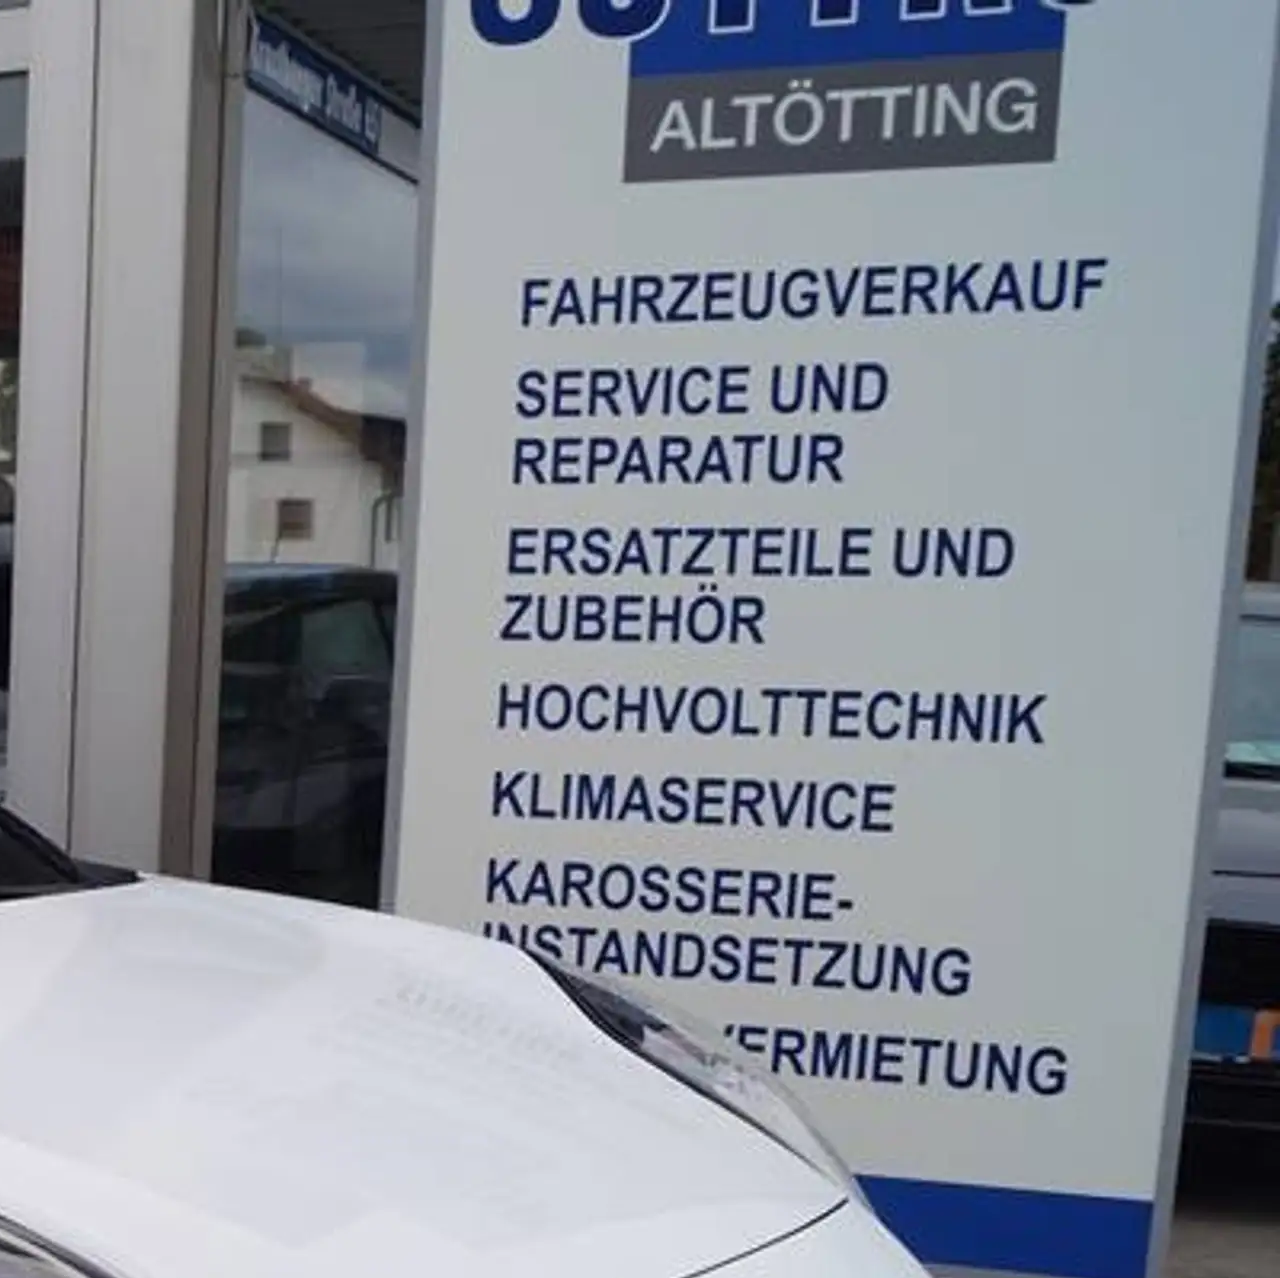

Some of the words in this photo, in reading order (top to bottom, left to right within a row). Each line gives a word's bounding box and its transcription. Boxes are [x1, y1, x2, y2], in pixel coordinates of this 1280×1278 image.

[650, 80, 1035, 151] ALTÖTTING
[522, 258, 1108, 327] FAHRZEUGVERKAUF
[516, 366, 750, 418] SERVICE
[771, 363, 888, 413] UND
[513, 434, 843, 484] REPARATUR
[508, 528, 872, 576] ERSATZTEILE
[894, 528, 1014, 577] UND
[500, 584, 764, 644] ZUBEHÖR
[498, 684, 1046, 743] HOCHVOLTTECHNIK
[493, 772, 895, 832] KLIMASERVICE
[487, 858, 853, 921] KAROSSERIE-
[724, 1024, 1067, 1095] ERMIETUNG
